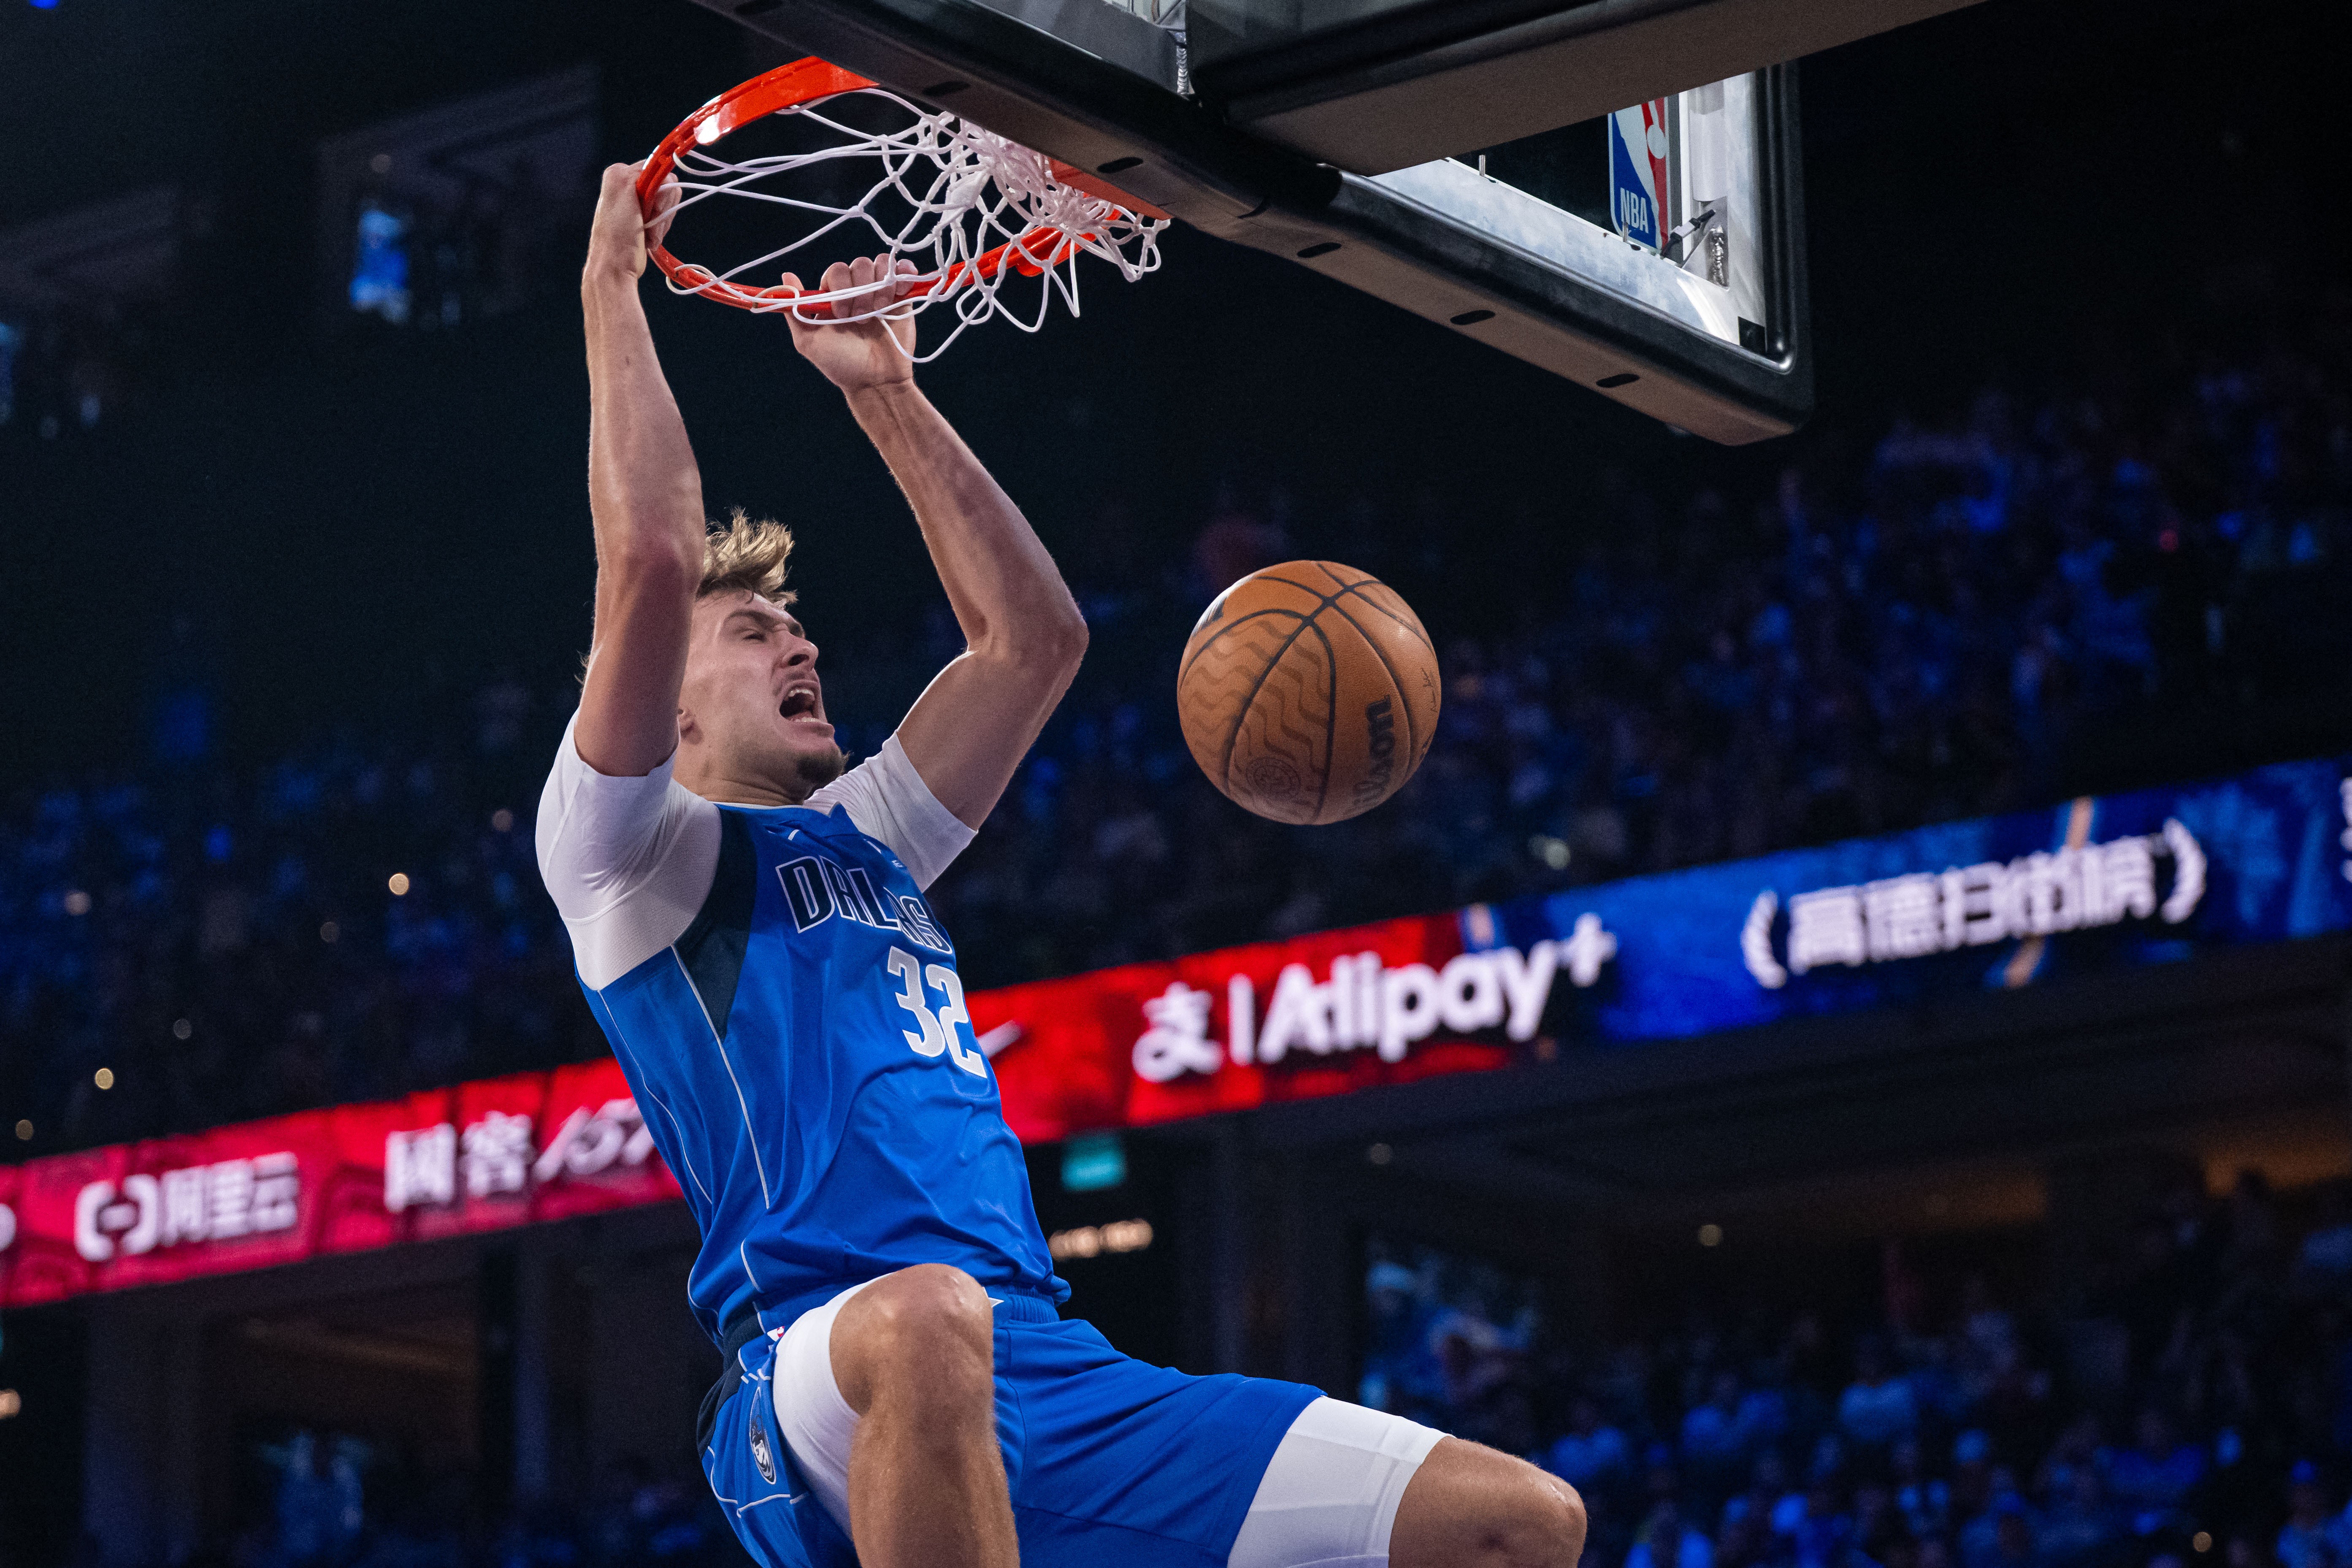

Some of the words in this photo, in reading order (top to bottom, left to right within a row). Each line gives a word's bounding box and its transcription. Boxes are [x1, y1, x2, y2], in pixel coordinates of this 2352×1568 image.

[1620, 187, 1649, 234] NBA
[1348, 694, 1395, 811] ilson
[775, 855, 953, 954] DALAS
[887, 945, 988, 1079] 32
[1259, 913, 1617, 1064] Alipay+
